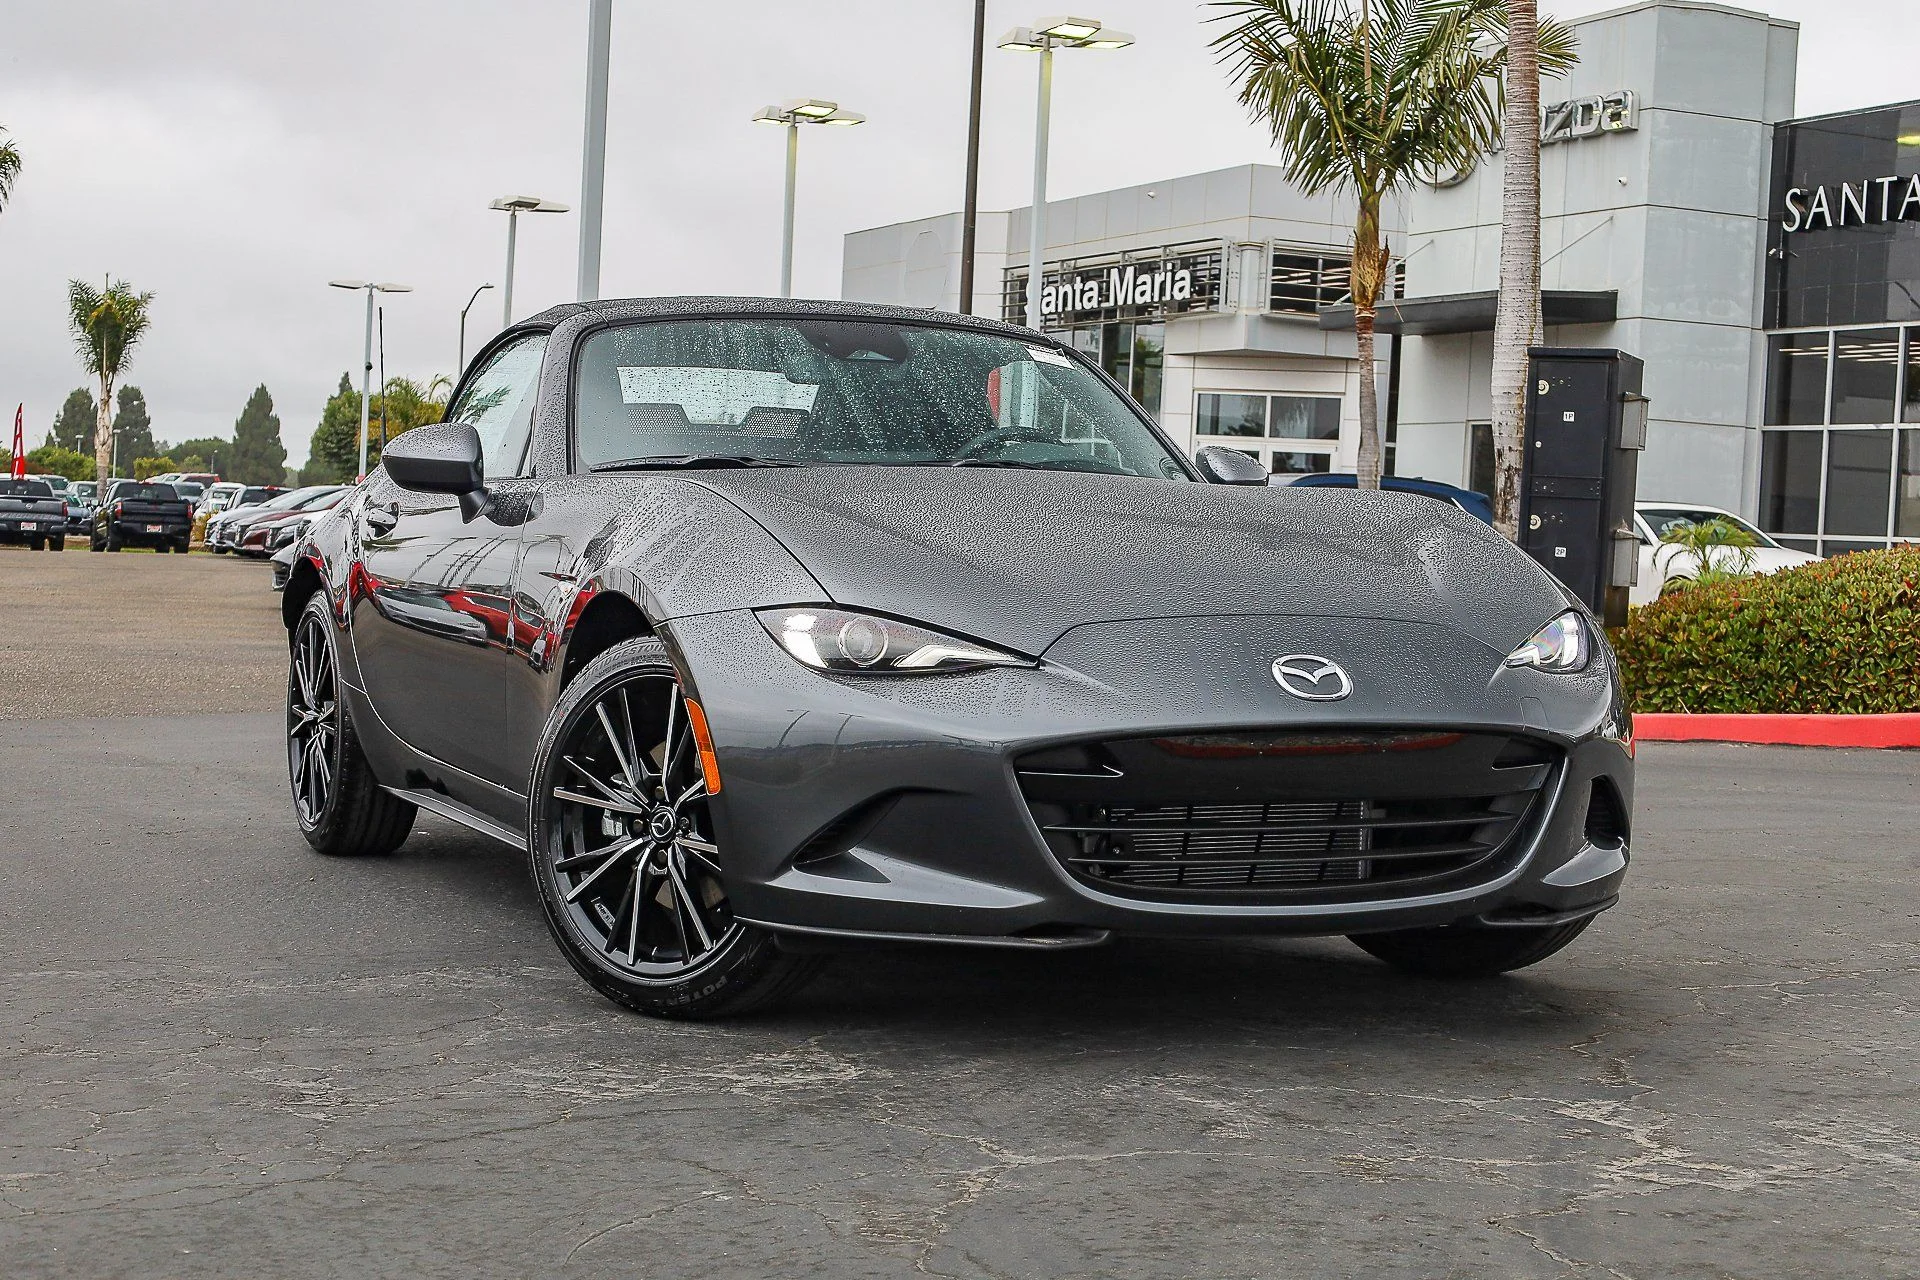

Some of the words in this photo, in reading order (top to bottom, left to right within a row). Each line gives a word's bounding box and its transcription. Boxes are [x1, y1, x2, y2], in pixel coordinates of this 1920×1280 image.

[1782, 173, 1920, 233] SANTA
[1025, 273, 1099, 316] anta
[1108, 262, 1191, 307] Maria
